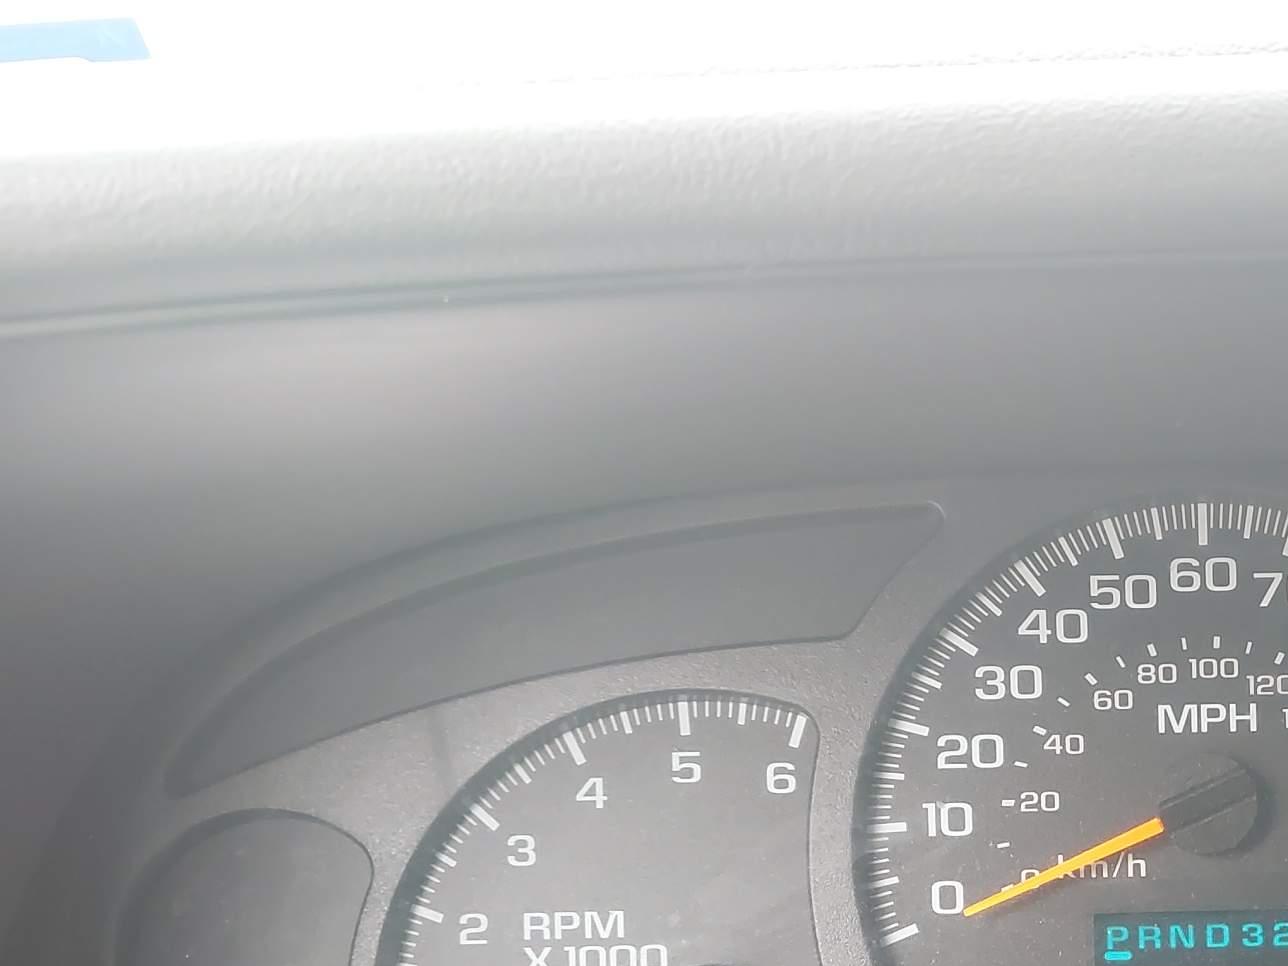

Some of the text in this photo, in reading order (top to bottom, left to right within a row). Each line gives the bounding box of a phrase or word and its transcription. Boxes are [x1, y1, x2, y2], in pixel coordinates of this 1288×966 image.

[1170, 558, 1237, 592] 60
[1090, 575, 1157, 609] 50
[1018, 610, 1088, 644] 40
[976, 666, 1042, 700] 30
[1138, 664, 1177, 684] 80
[1189, 658, 1239, 679] 100
[1094, 690, 1133, 711] 60
[1157, 703, 1257, 734] MPH
[938, 735, 1004, 770] 20
[1043, 734, 1085, 755] 40
[672, 751, 701, 783] 5
[767, 763, 797, 794] 6
[576, 778, 608, 809] 4
[1020, 791, 1060, 812] 20
[922, 802, 973, 837] 10
[507, 835, 537, 867] 3
[931, 881, 964, 916] 0
[459, 914, 489, 945] 2
[523, 910, 625, 940] RPM
